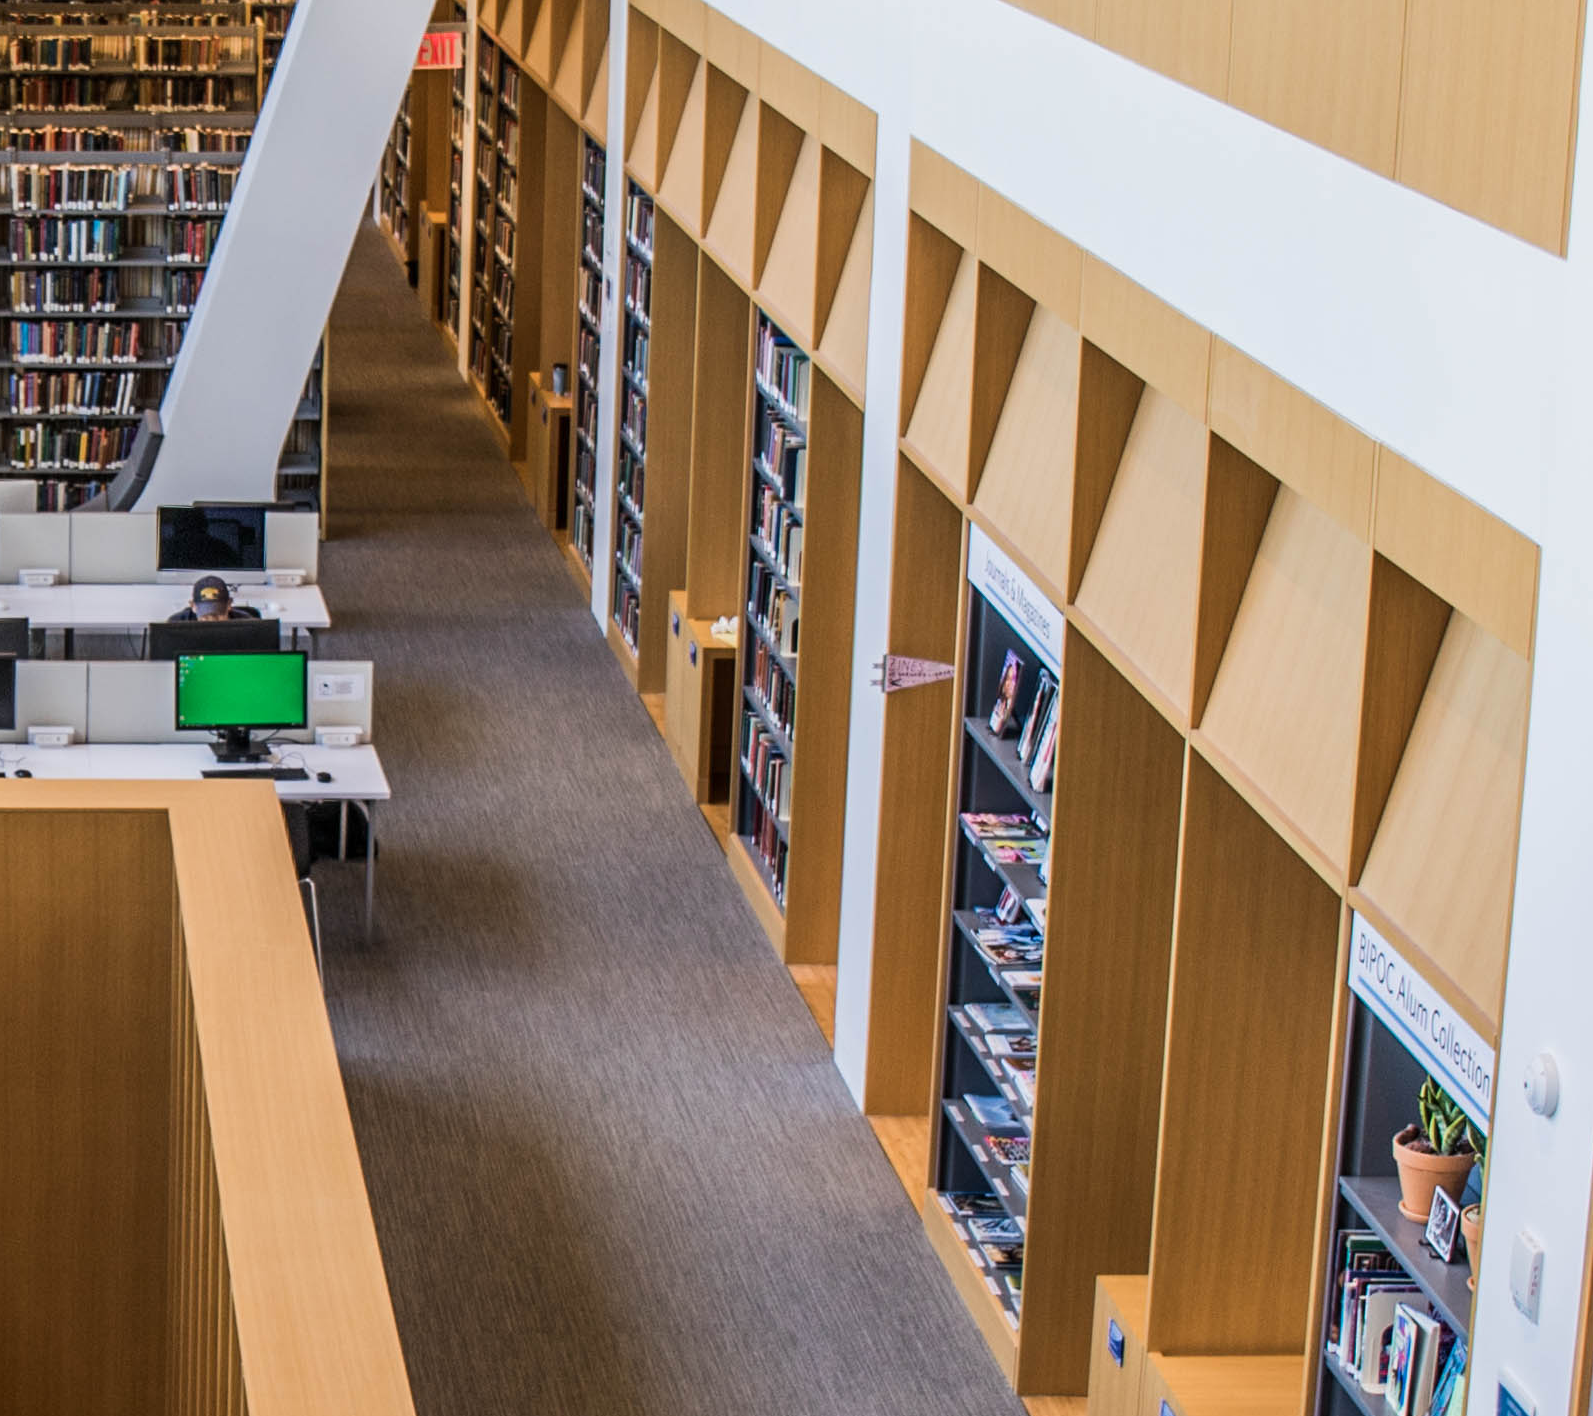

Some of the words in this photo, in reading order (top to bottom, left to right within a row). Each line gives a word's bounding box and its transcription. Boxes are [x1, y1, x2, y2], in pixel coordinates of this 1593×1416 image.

[416, 32, 459, 66] EXIT
[984, 550, 1011, 596] Journals
[1018, 584, 1051, 640] Magazines
[1358, 933, 1395, 995] BIPOC
[1396, 974, 1428, 1032] Alum
[1431, 1009, 1491, 1100] Collection
